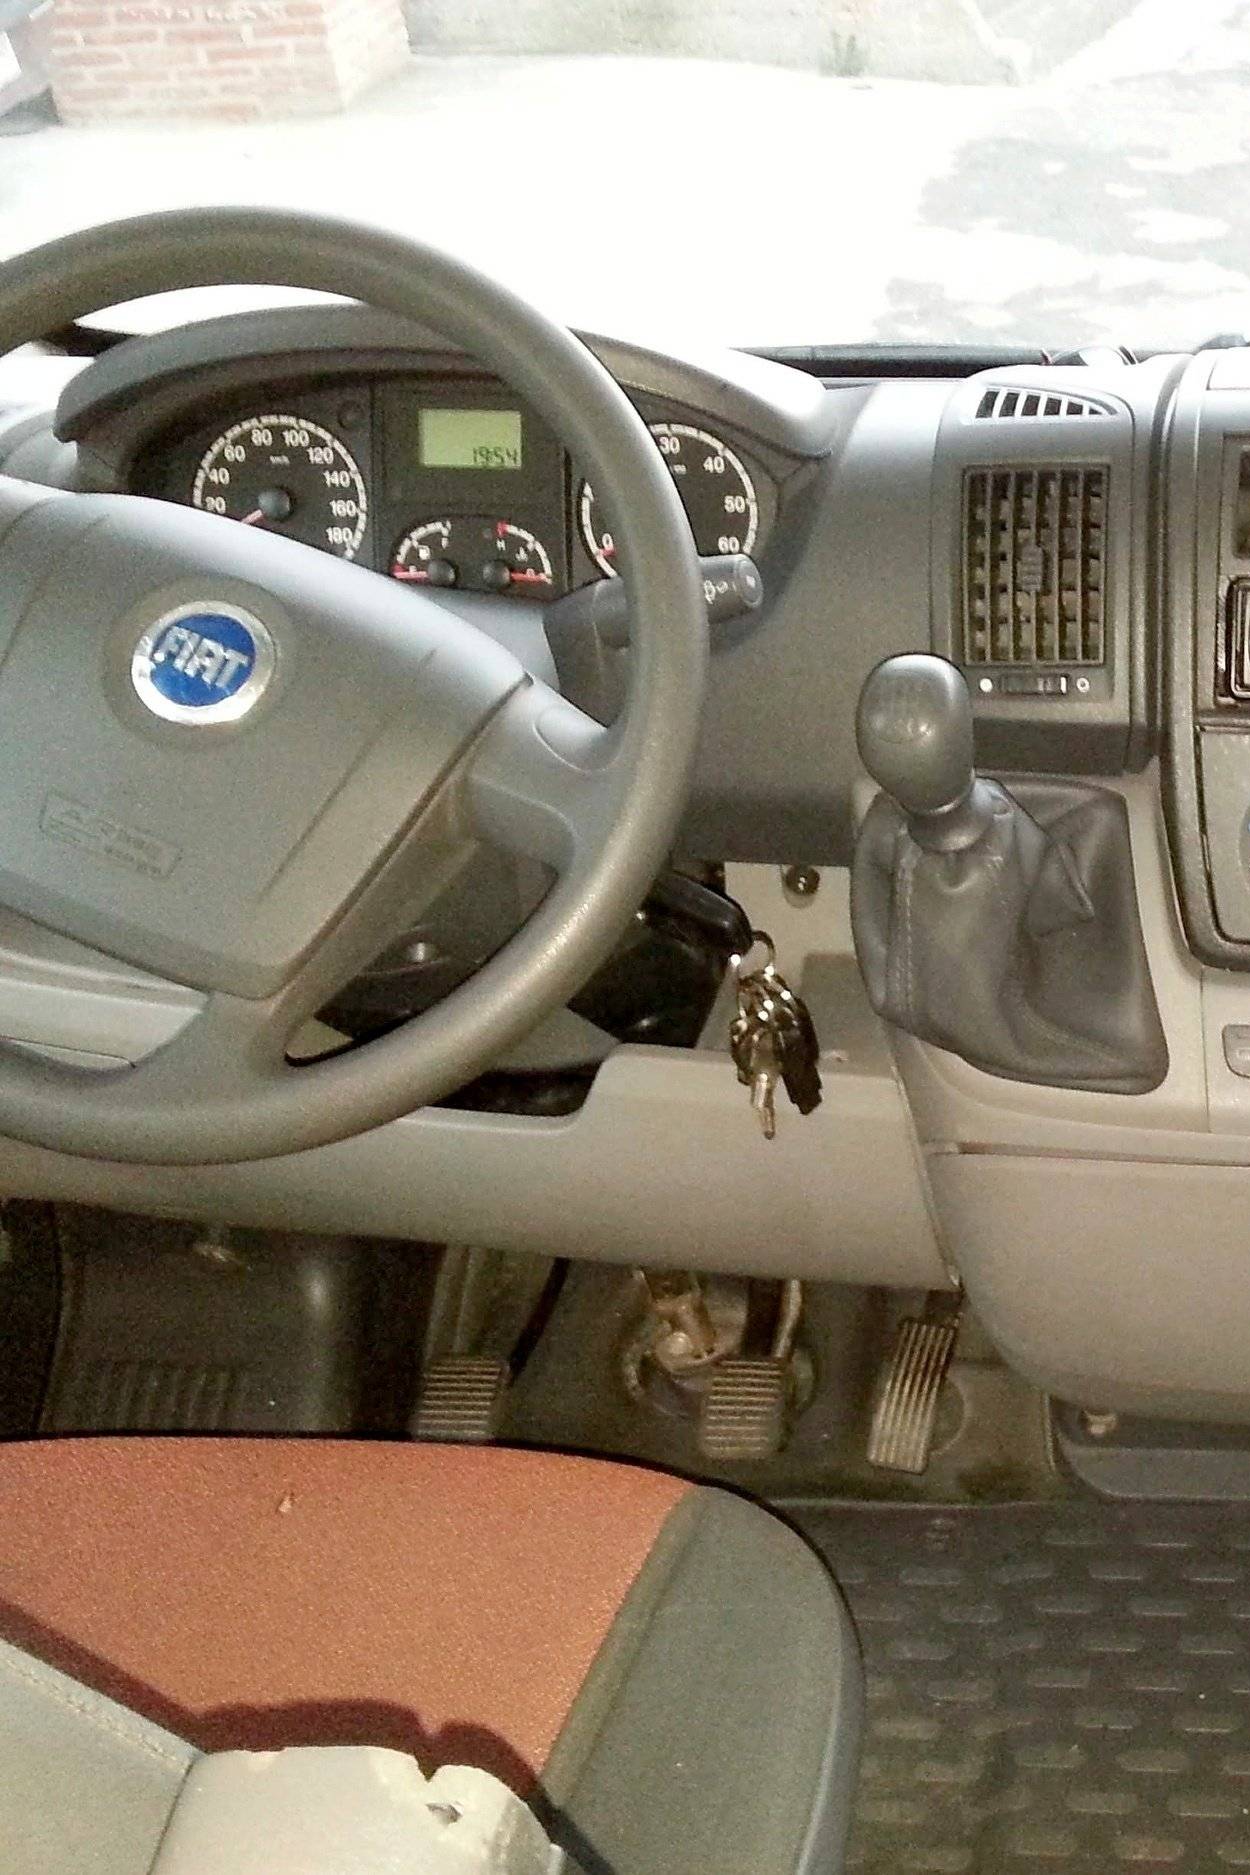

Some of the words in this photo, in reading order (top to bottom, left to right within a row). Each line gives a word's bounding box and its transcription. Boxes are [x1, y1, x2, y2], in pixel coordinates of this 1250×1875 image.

[250, 428, 273, 446] 80
[282, 429, 310, 447] 100
[658, 436, 681, 454] 30
[224, 445, 246, 462] 60
[306, 447, 334, 464] 120
[702, 456, 725, 474] 40
[208, 467, 230, 485] 40
[322, 470, 351, 488] 140
[205, 497, 226, 514] 20
[329, 499, 357, 517] 160
[724, 495, 746, 514] 50
[325, 527, 353, 545] 180
[717, 536, 740, 553] 60
[153, 626, 249, 688] FIAT
